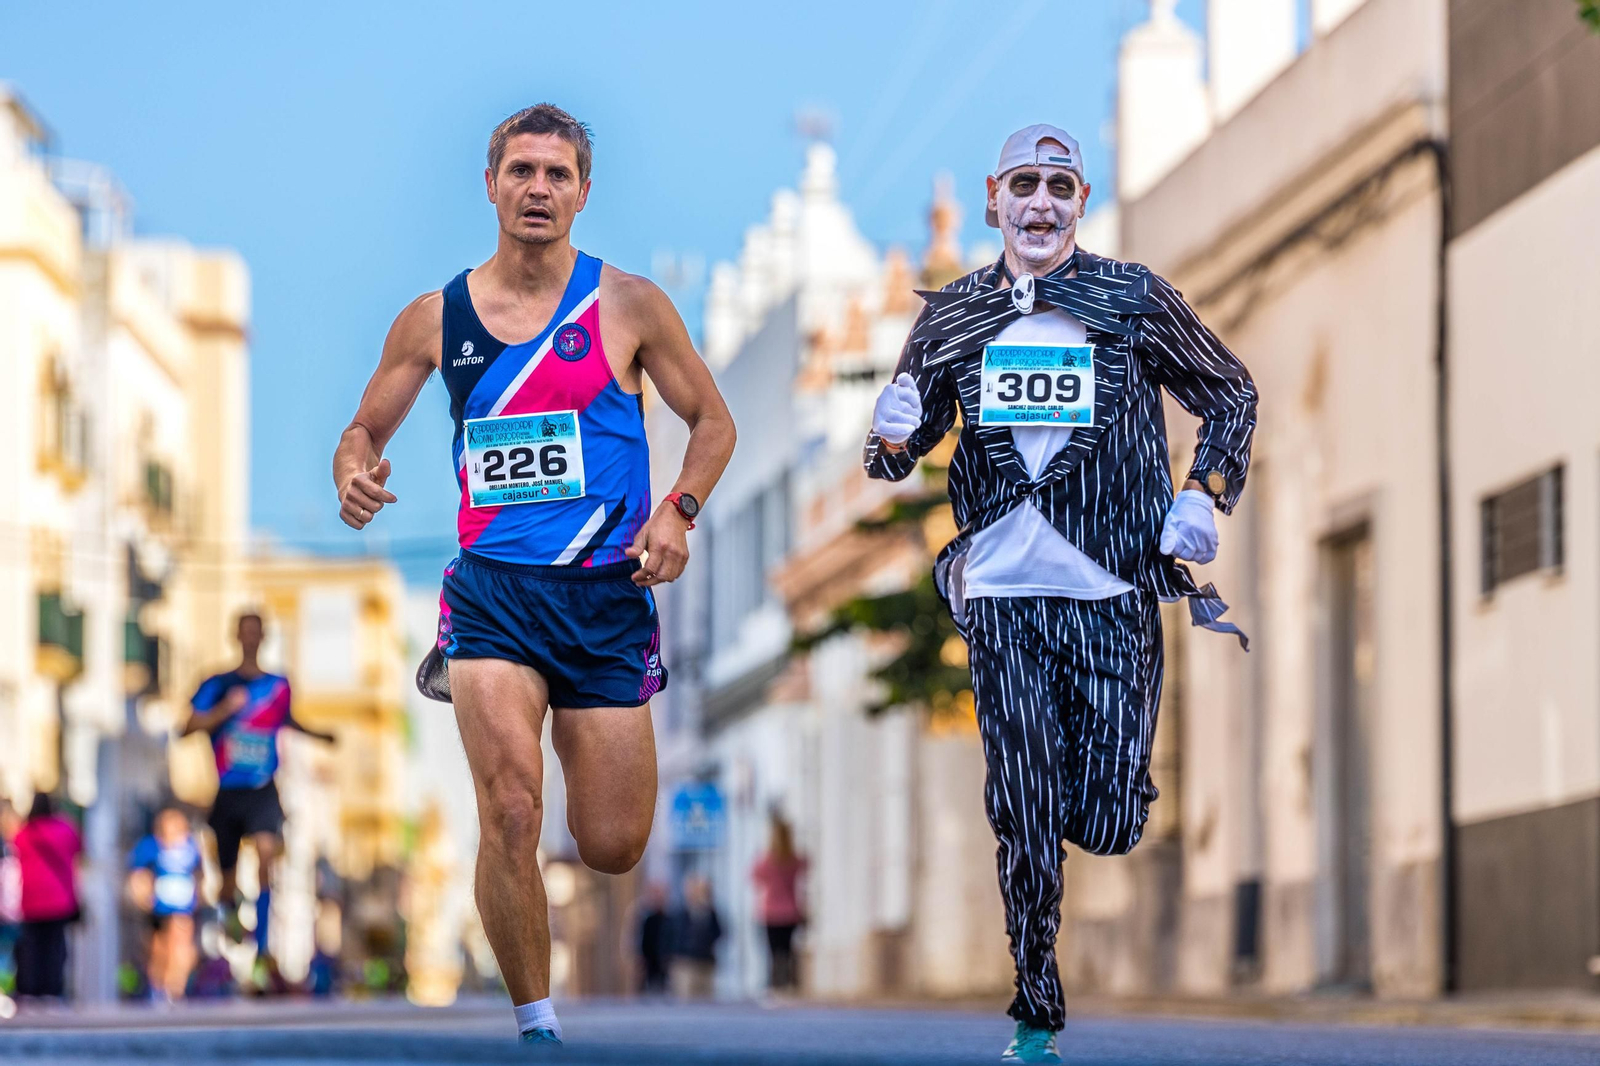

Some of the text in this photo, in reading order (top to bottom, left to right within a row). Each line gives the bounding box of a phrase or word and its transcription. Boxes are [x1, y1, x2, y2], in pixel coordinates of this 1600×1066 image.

[452, 356, 484, 367] VIATOR
[997, 372, 1081, 403] 309
[1015, 411, 1052, 421] cajasur
[482, 444, 568, 482] 226
[489, 483, 508, 491] ORELLANA
[531, 479, 543, 487] JOSÉ
[544, 478, 564, 486] MANUEL
[502, 489, 540, 502] cajasur
